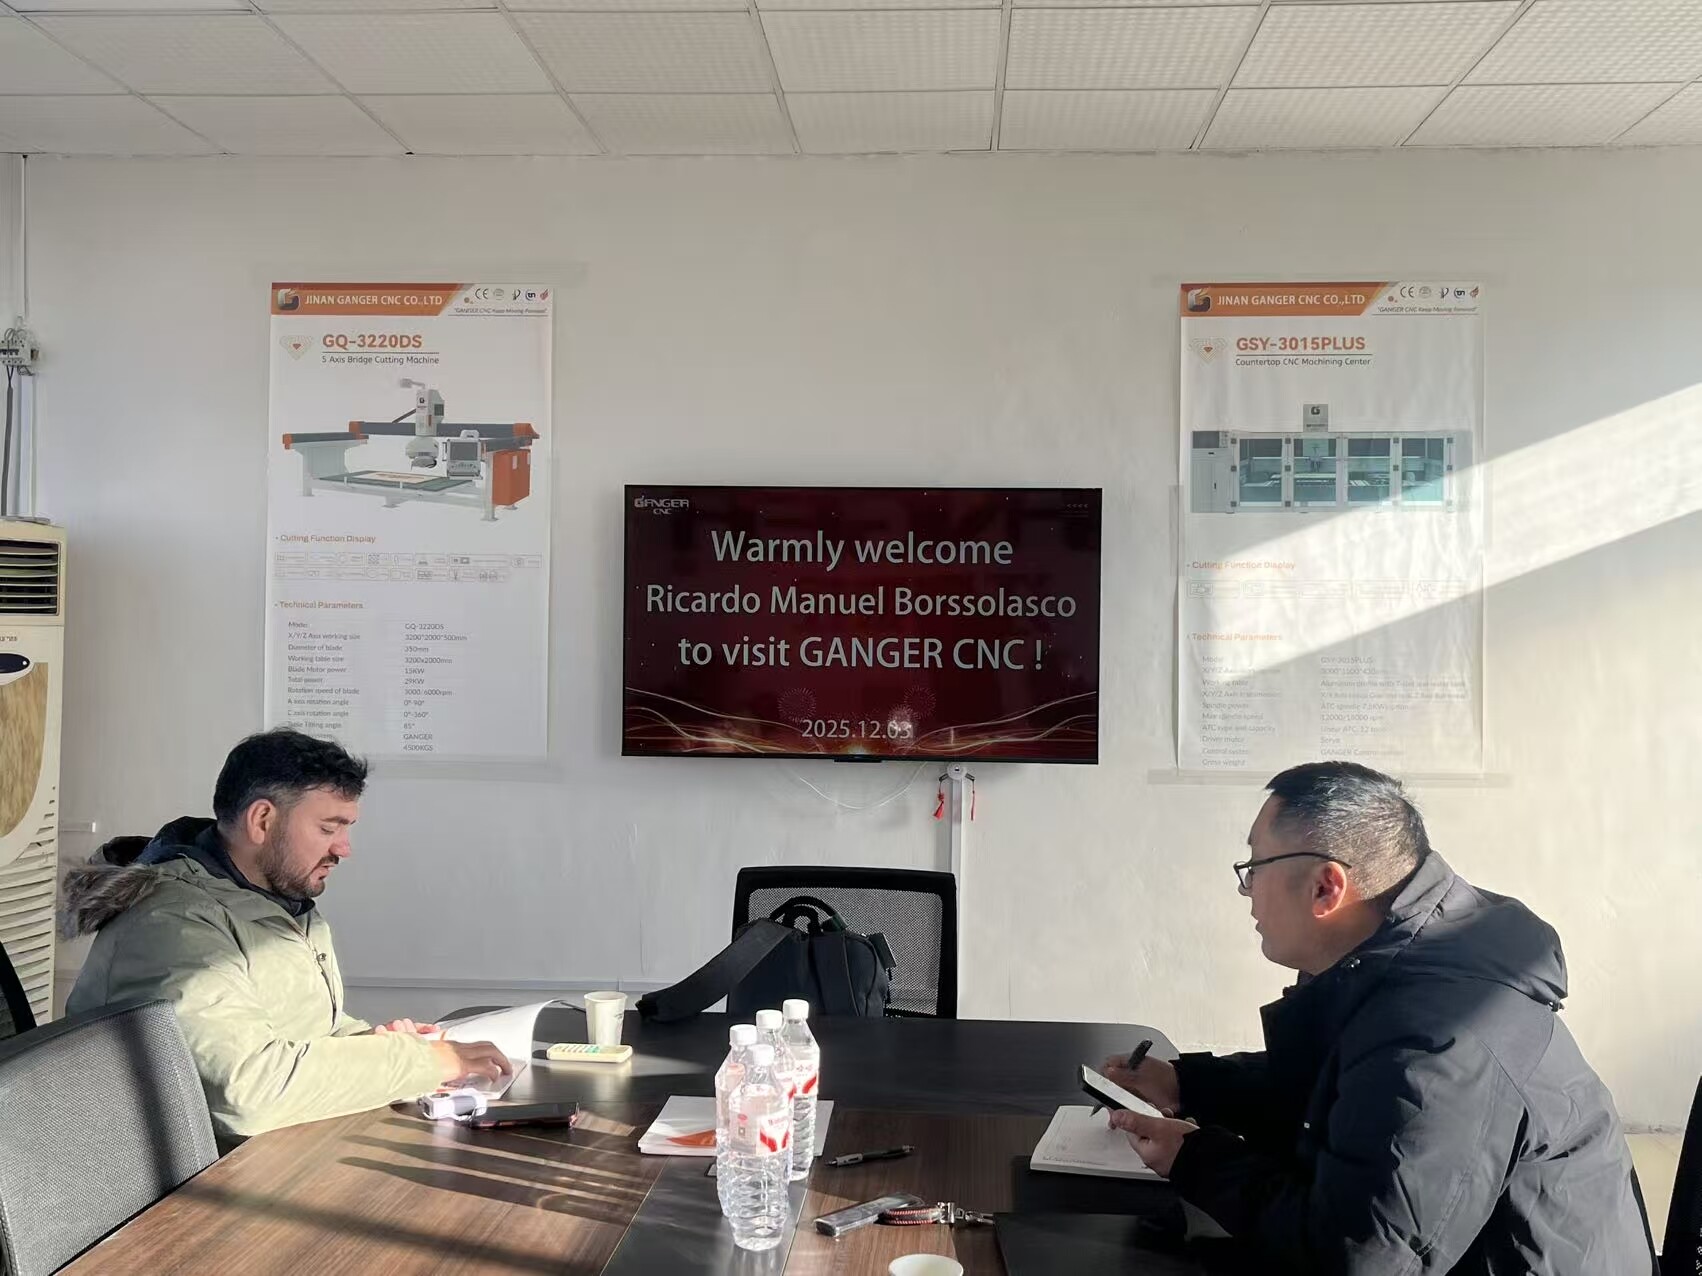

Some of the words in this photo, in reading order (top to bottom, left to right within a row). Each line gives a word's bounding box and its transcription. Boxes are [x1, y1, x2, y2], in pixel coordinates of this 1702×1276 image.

[304, 295, 335, 305] JINAN
[337, 295, 378, 305] GANGER
[380, 295, 402, 305] CNC
[1216, 295, 1249, 306] JINAN
[1251, 295, 1296, 306] GANGER
[1298, 295, 1321, 306] CNC
[1323, 294, 1366, 307] CO.,LTD
[322, 334, 423, 350] GQ-3220DS
[1236, 336, 1366, 351] GSY-3015PLUS
[329, 355, 346, 363] Axis
[347, 355, 373, 365] Bridge
[374, 355, 404, 365] Cutting
[406, 355, 440, 364] Machine
[1235, 358, 1281, 367] Countertop
[1283, 358, 1299, 366] CNC
[1301, 357, 1343, 367] Machining
[1344, 357, 1371, 365] Center
[280, 534, 309, 543] Cutting
[346, 535, 377, 544] Display
[710, 530, 845, 571] Warmly
[854, 531, 1014, 565] welcome
[1263, 561, 1296, 570] Display
[279, 601, 316, 609] Technical
[317, 601, 364, 609] Parameters
[646, 584, 761, 614] Ricardo
[771, 585, 884, 616] Manuel
[895, 587, 1077, 618] Borssolasco
[1234, 633, 1282, 641] Parameters
[678, 639, 712, 666] to
[722, 635, 791, 667] visit
[799, 637, 944, 670] GANGER
[952, 638, 1025, 670] CNC
[1034, 639, 1043, 670] !
